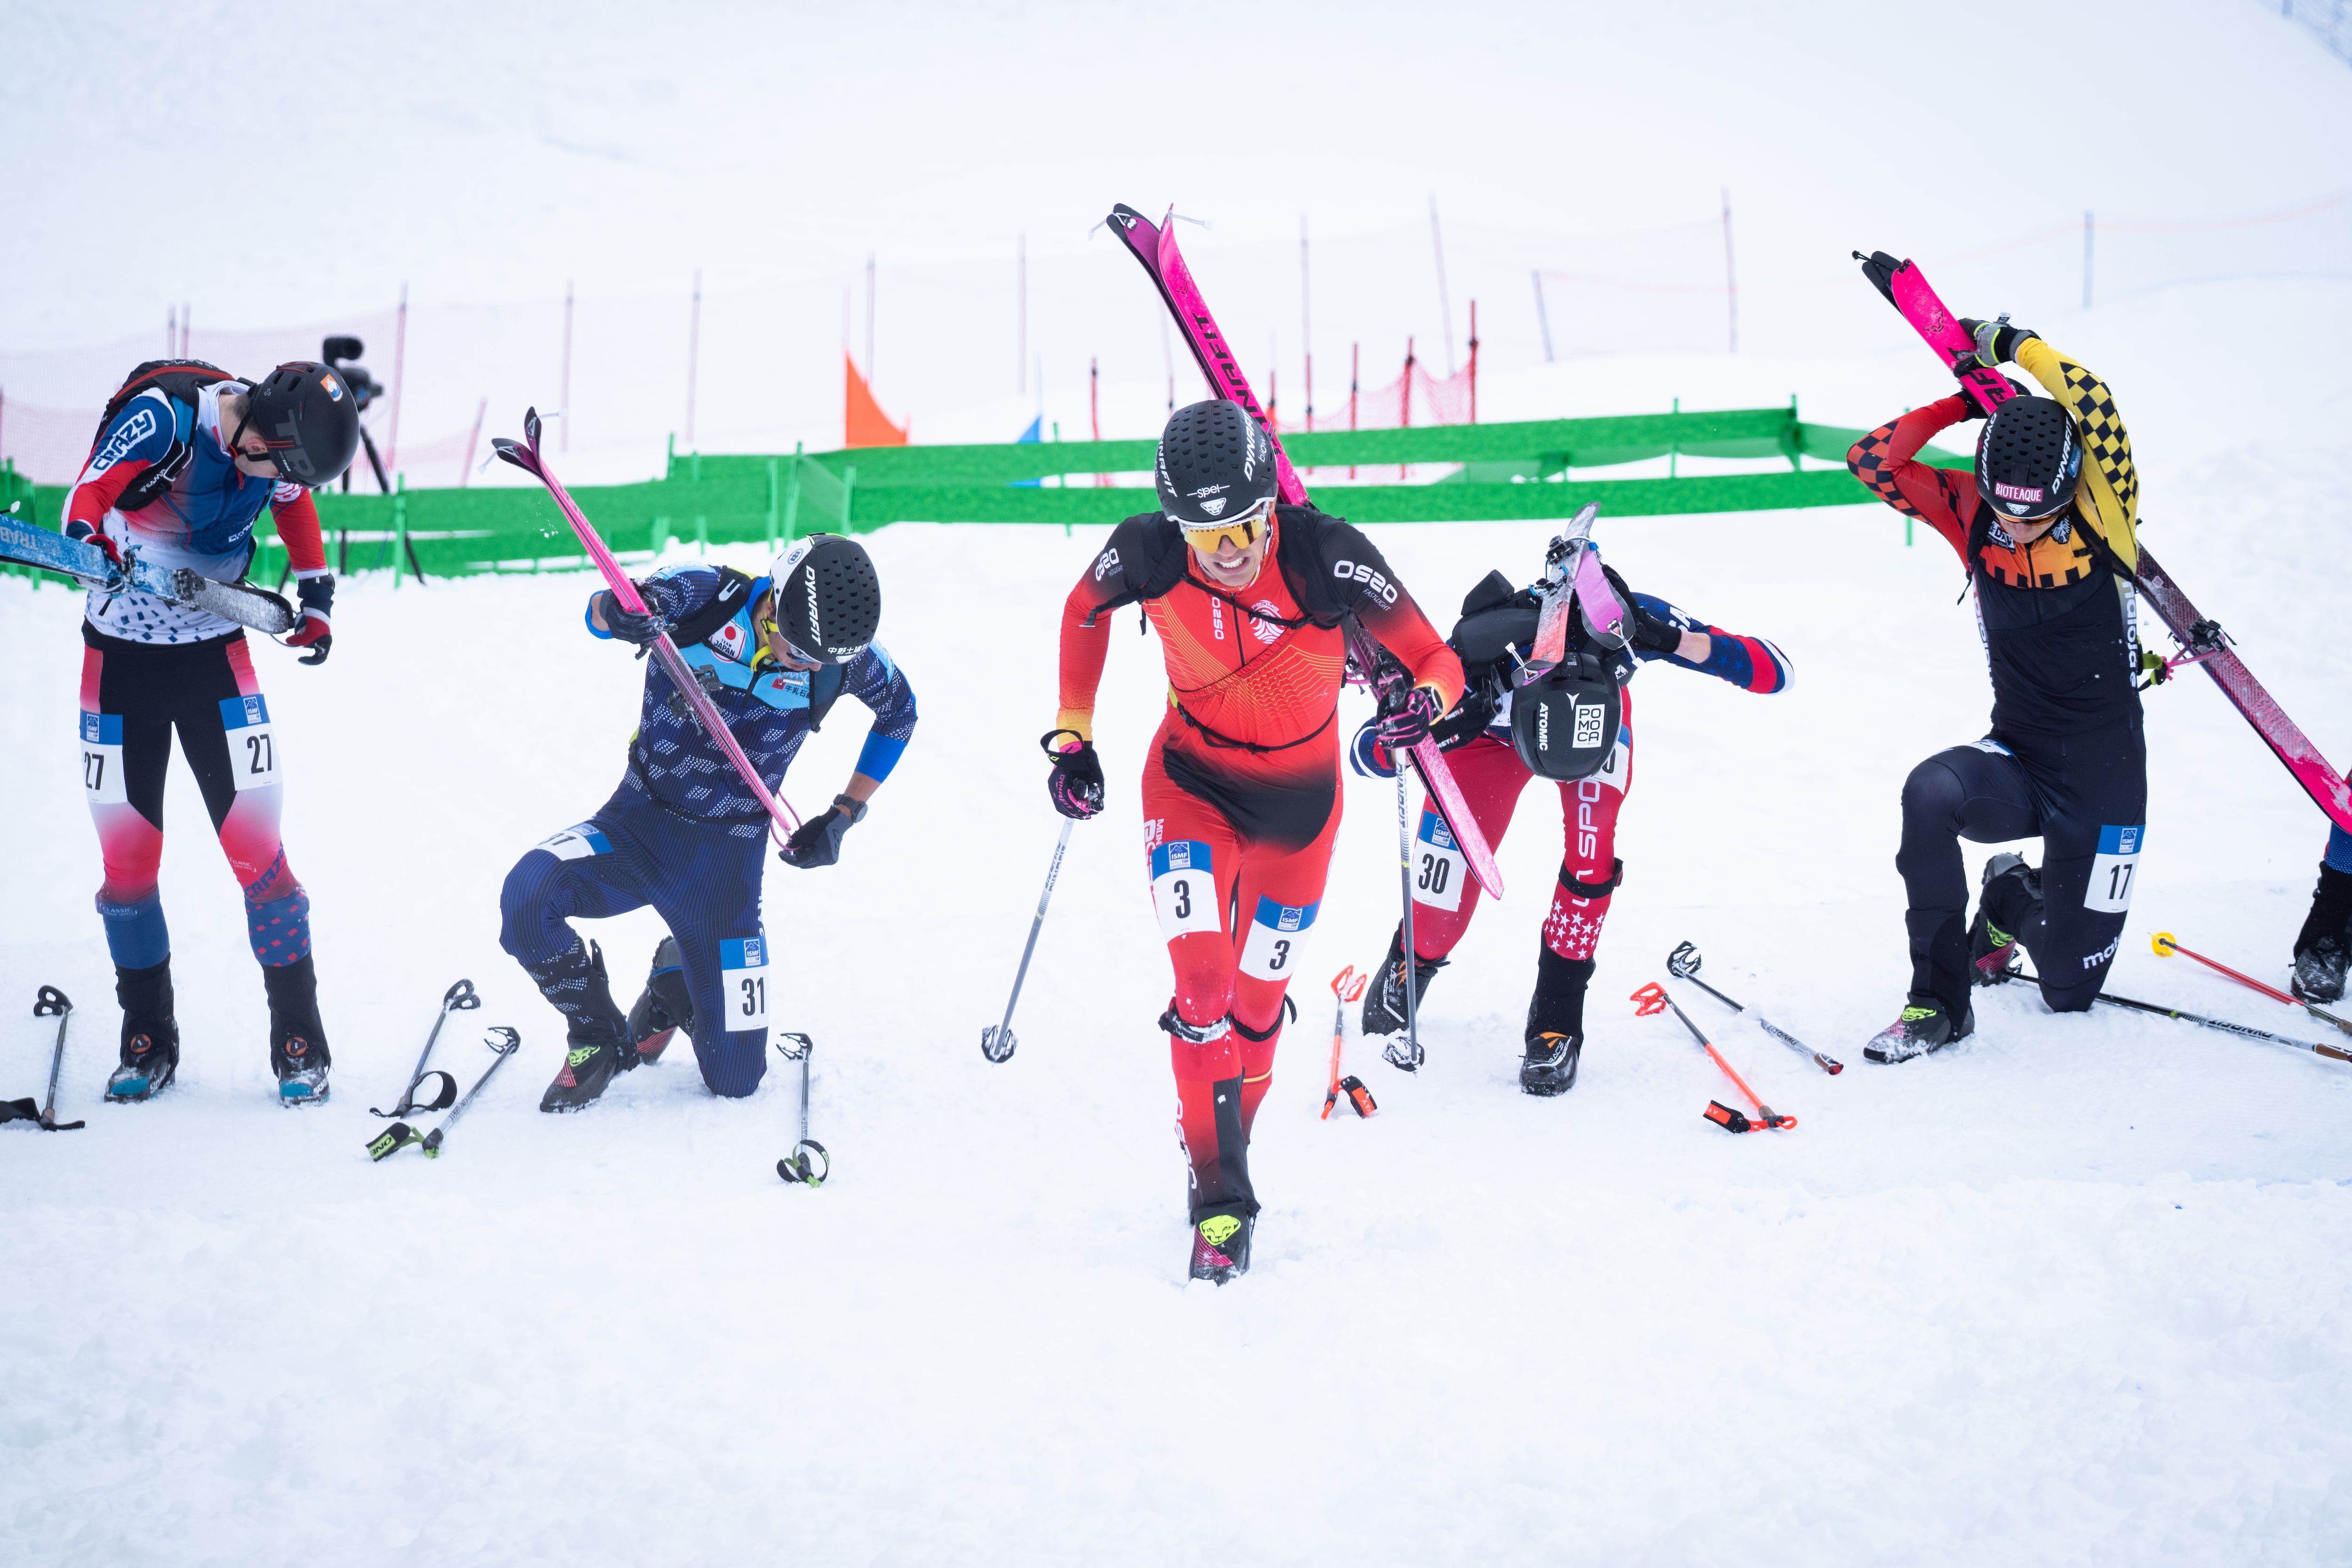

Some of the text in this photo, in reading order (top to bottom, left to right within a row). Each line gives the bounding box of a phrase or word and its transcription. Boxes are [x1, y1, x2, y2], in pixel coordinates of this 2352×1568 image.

[93, 410, 154, 470] CRAZY
[1981, 412, 1997, 490] DYNAFIT
[2052, 416, 2072, 495] DYNAFIT
[1197, 484, 1220, 498] spel
[1996, 483, 2042, 501] BIOTEAQUE
[805, 565, 821, 646] DYNAFIT
[714, 640, 735, 657] JAPAN
[721, 638, 732, 648] TEAM
[1539, 702, 1549, 751] ATOMIC
[1578, 720, 1600, 730] MO
[1579, 708, 1601, 719] PO
[247, 734, 272, 774] 27
[1577, 731, 1599, 742] CA
[85, 751, 104, 790] 27
[1059, 774, 1073, 809] DYNAFIT
[1418, 853, 1450, 894] 30
[2109, 863, 2133, 899] 17
[1174, 879, 1191, 919] 3
[1270, 940, 1290, 970] 3
[741, 976, 764, 1016] 31
[370, 1137, 392, 1156] ONE
